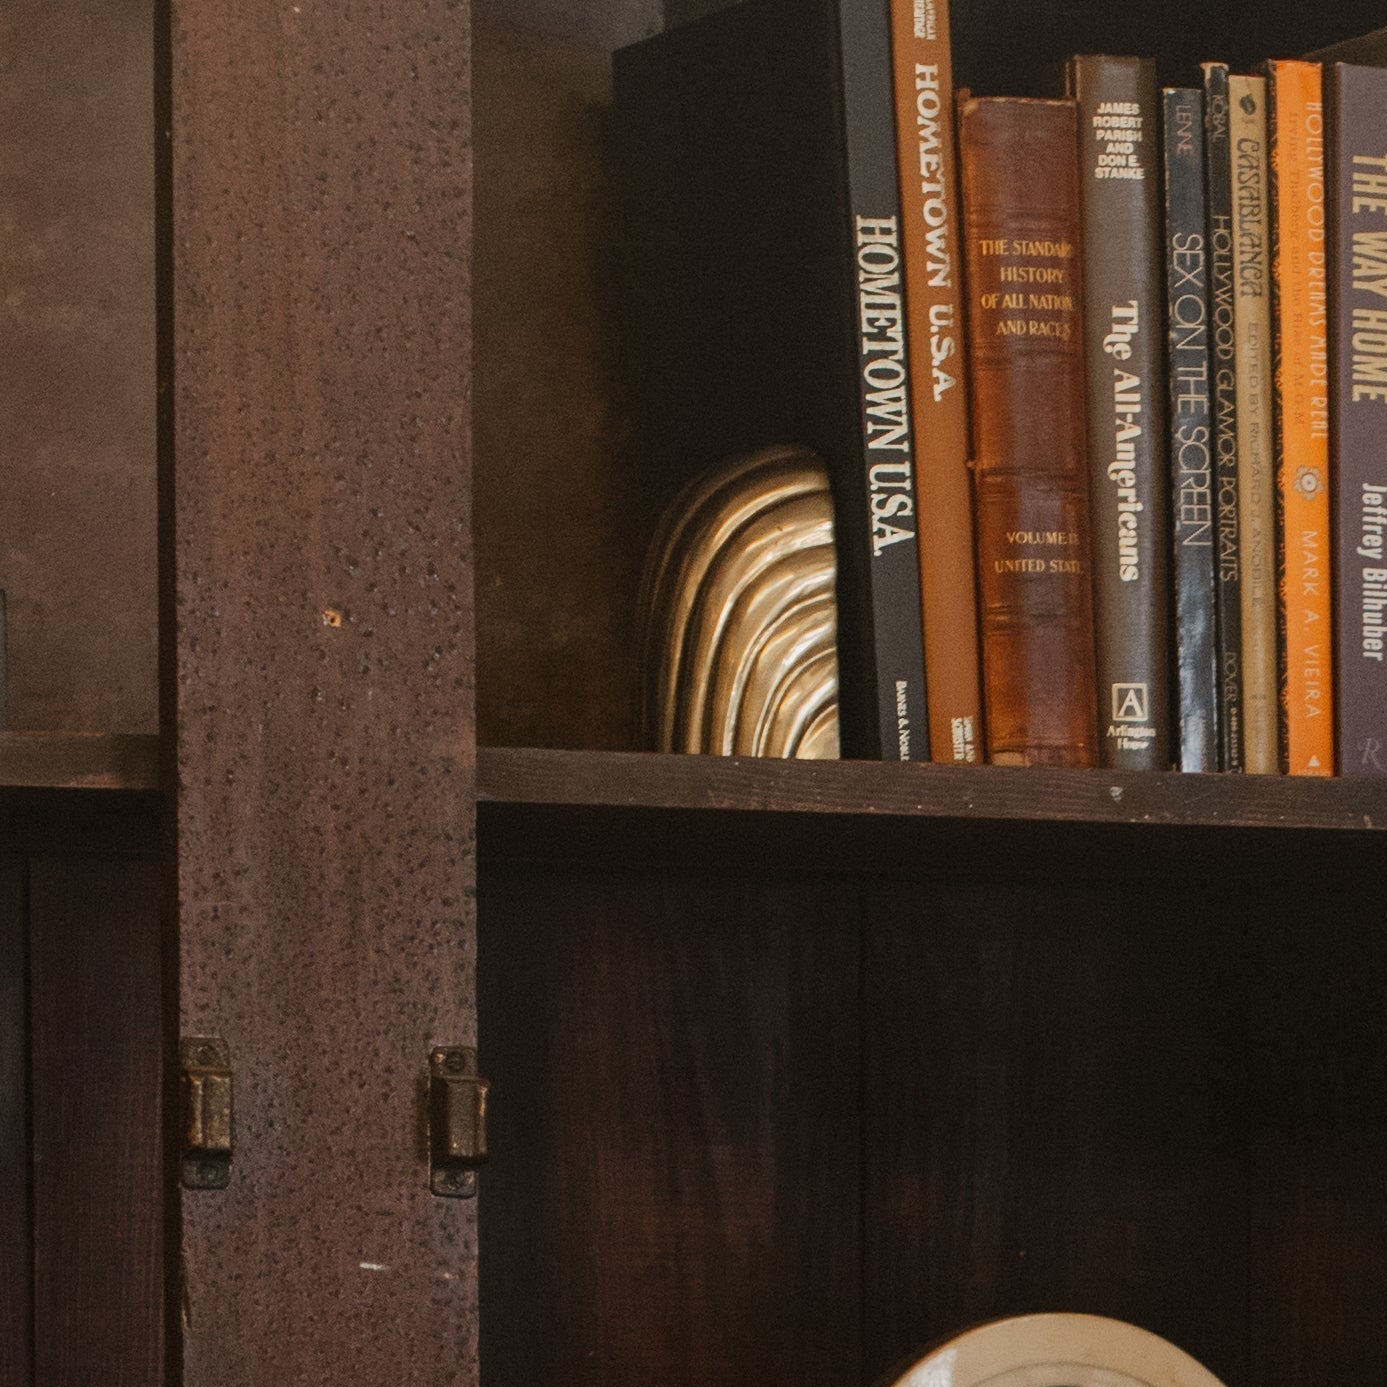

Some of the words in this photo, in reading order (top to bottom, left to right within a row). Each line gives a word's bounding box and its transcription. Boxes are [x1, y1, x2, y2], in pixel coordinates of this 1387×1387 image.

[1092, 116, 1143, 128] ROBERT
[1095, 129, 1142, 142] PARISH
[1097, 102, 1140, 115] JAMES
[915, 63, 951, 287] HOMETOWN
[1094, 167, 1145, 180] STANKE
[1098, 154, 1126, 167] DON
[1105, 142, 1134, 154] AND
[1305, 101, 1325, 242] HOLLYWOOD
[1236, 137, 1263, 298] CASABLANCA
[979, 240, 1009, 256] THE
[1000, 267, 1065, 283] HISTORY
[1172, 232, 1205, 288] SEX
[981, 293, 1000, 309] OF
[1001, 293, 1028, 309] ALL
[1212, 214, 1235, 359] HOLLYWOOD
[1309, 252, 1327, 327] DREAMS
[856, 214, 909, 452] HOMETOWN
[996, 320, 1027, 336] AND
[1103, 300, 1140, 361] The
[1174, 294, 1207, 350] ON
[1247, 322, 1258, 388] EDITED
[1310, 335, 1328, 386] MADE
[1177, 360, 1208, 414] THE
[1249, 392, 1259, 417] BY
[1215, 368, 1236, 468] GLAMOR
[1311, 396, 1329, 439] REAL
[1107, 368, 1143, 583] All-Americans
[1178, 425, 1213, 546] SCREEN
[1250, 422, 1261, 505] RICHARD
[1006, 531, 1067, 544] VOLUME
[1217, 476, 1239, 582] PORTRAITS
[994, 559, 1045, 573] UNITED
[1302, 530, 1318, 596] MARK
[1303, 608, 1320, 632] A.
[1224, 651, 1238, 702] DOVER
[1304, 644, 1321, 719] VIEIRA
